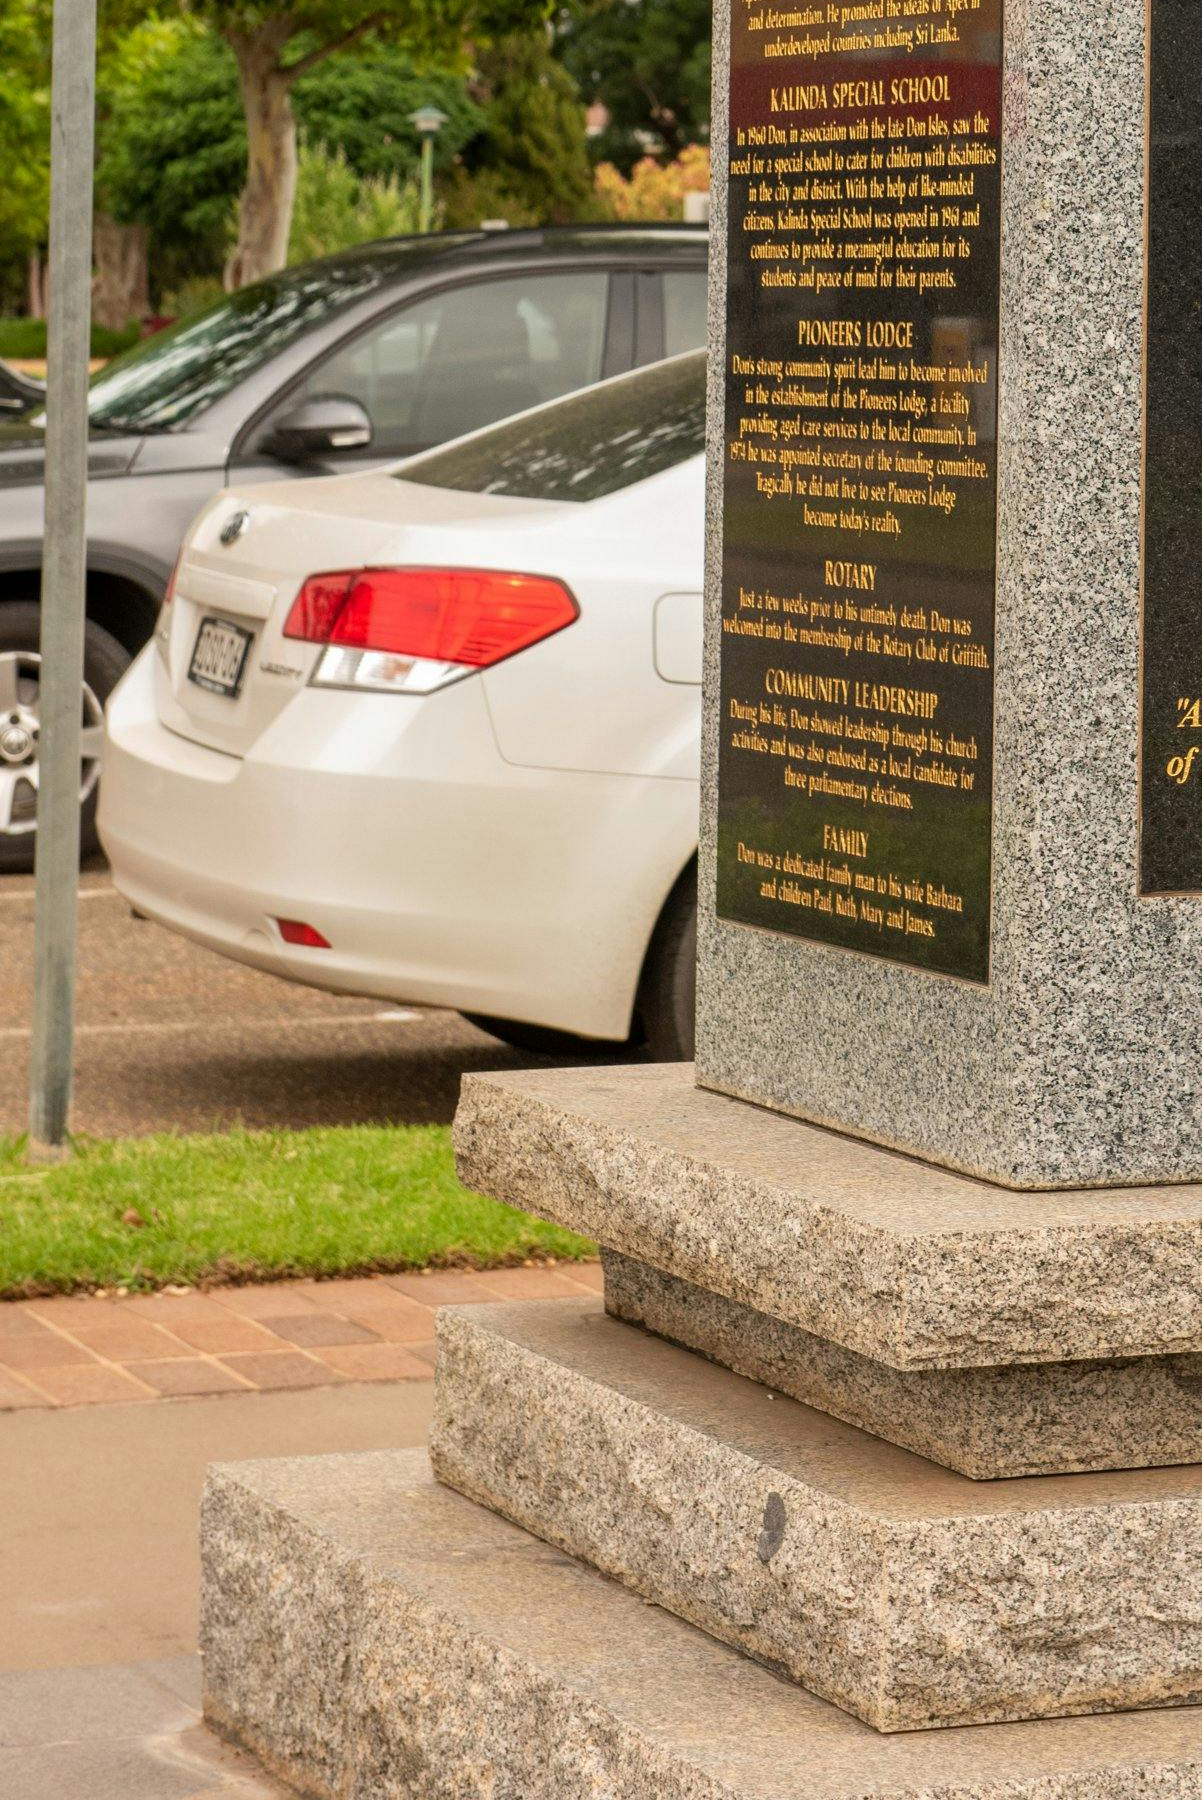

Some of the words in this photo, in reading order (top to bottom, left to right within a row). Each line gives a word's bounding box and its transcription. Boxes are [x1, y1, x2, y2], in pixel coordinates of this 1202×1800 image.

[747, 10, 763, 31] and
[765, 5, 824, 29] determination.
[826, 3, 839, 24] He
[764, 33, 830, 59] underdeveloped
[831, 30, 871, 52] countries
[873, 26, 913, 51] including
[915, 24, 928, 45] Sri
[929, 22, 959, 44] Lanka.
[770, 85, 827, 112] KALINDA
[832, 81, 885, 108] SPECIAL
[890, 76, 950, 104] SCHOOL
[748, 183, 756, 202] in
[758, 182, 772, 202] the
[774, 182, 789, 206] city
[792, 181, 808, 201] and
[810, 180, 842, 200] district.
[845, 178, 867, 199] With
[869, 178, 884, 198] the
[886, 177, 906, 203] help
[908, 177, 918, 197] of
[920, 175, 974, 197] like-minded
[749, 240, 789, 260] continues
[791, 242, 800, 259] to
[802, 239, 834, 265] provide
[836, 245, 842, 259] a
[844, 238, 893, 264] meaningful
[895, 238, 939, 258] education
[941, 238, 955, 258] for
[957, 237, 970, 258] its
[760, 268, 796, 287] students
[798, 268, 814, 287] and
[815, 273, 841, 293] peace
[842, 267, 853, 287] of
[855, 267, 878, 287] mind
[879, 267, 892, 287] for
[895, 267, 916, 288] their
[918, 269, 956, 293] parents.
[798, 321, 861, 346] PIONEERS
[866, 322, 913, 347] LODGE
[745, 385, 753, 404] in
[755, 385, 769, 405] the
[771, 386, 828, 408] establishment
[830, 388, 840, 408] of
[842, 388, 857, 409] the
[859, 389, 897, 411] Pioneers
[898, 391, 927, 417] Lodge,
[930, 397, 936, 412] a
[939, 392, 970, 420] facility
[739, 414, 777, 440] providing
[779, 416, 800, 441] aged
[802, 422, 821, 437] care
[822, 418, 857, 439] services
[859, 422, 869, 440] to
[871, 420, 886, 441] the
[888, 421, 910, 442] local
[912, 424, 964, 451] community.
[967, 425, 976, 446] In
[803, 505, 837, 528] become
[839, 509, 869, 536] today's
[871, 512, 901, 539] reality.
[824, 561, 876, 590] ROTARY
[765, 670, 849, 705] COMMUNITY
[854, 683, 937, 719] LEADERSHIP
[1166, 746, 1200, 785] of
[783, 767, 806, 790] three
[808, 773, 868, 807] parliamentary
[870, 783, 913, 810] elections.
[823, 825, 868, 858] FAMILY
[759, 880, 776, 901] and
[777, 882, 811, 909] children
[813, 889, 833, 916] Paul,
[835, 894, 857, 922] Ruth,
[860, 900, 883, 931] Mary
[886, 908, 903, 930] and
[905, 910, 935, 937] James.
